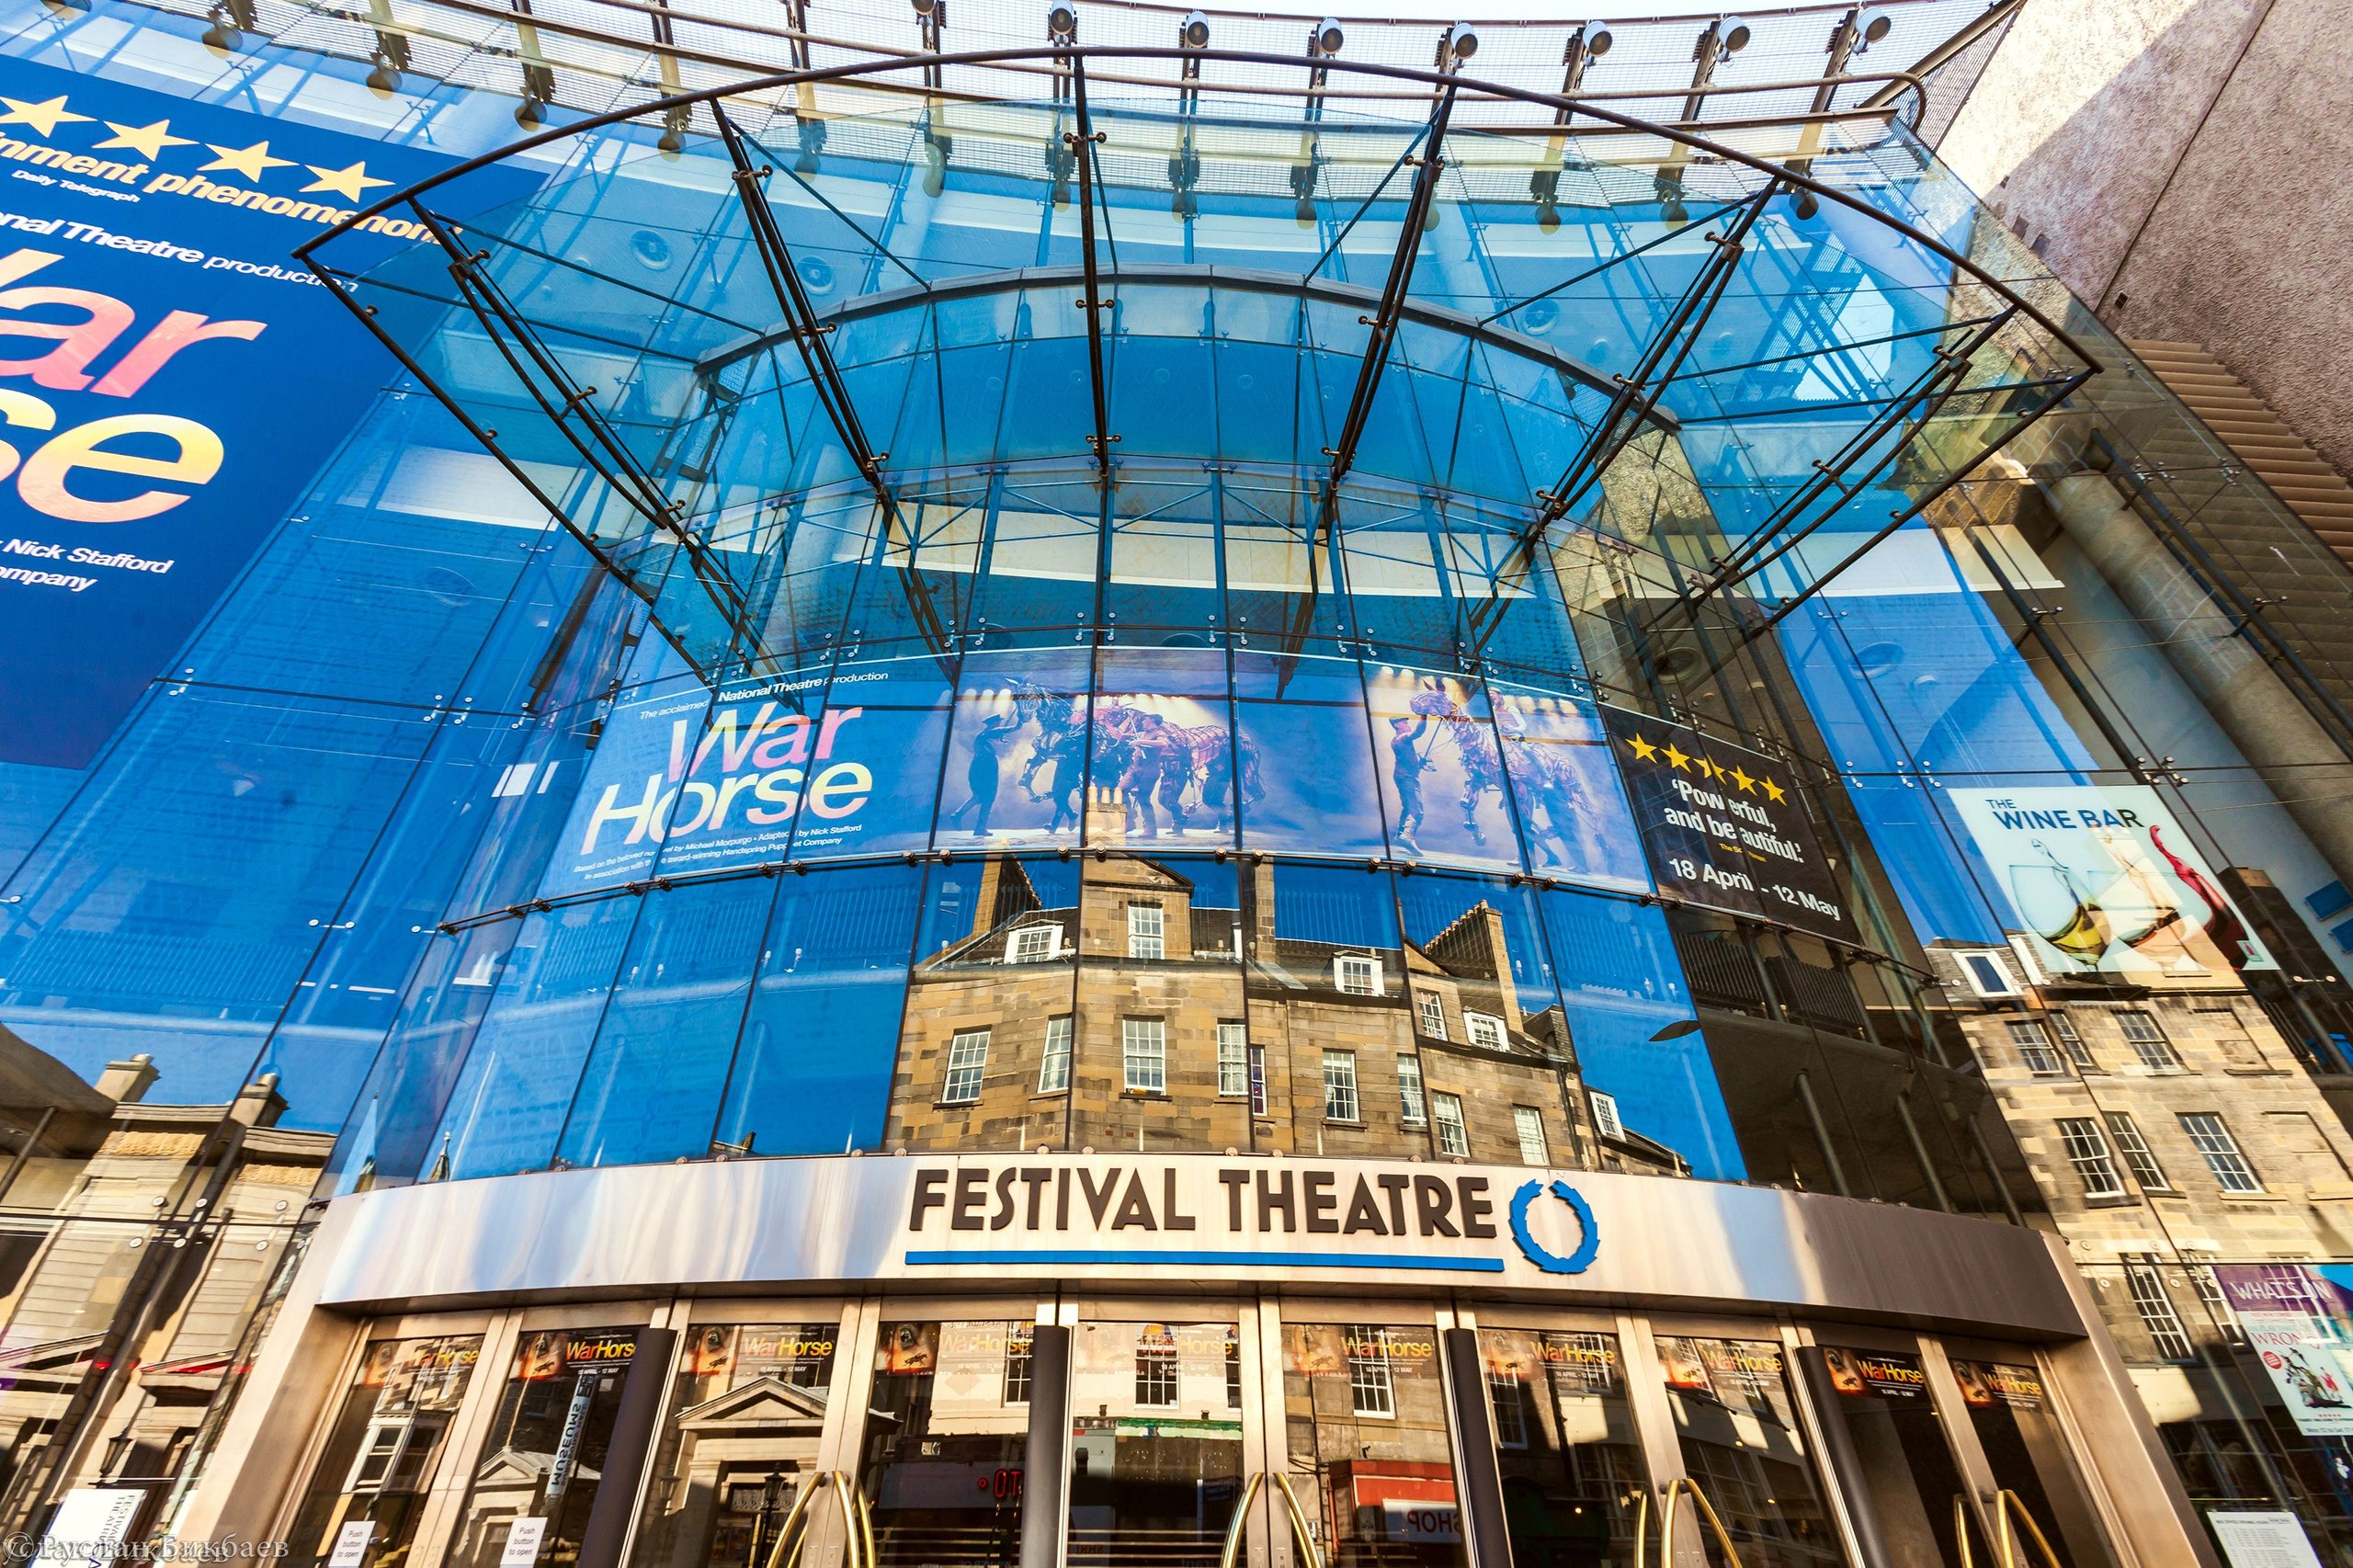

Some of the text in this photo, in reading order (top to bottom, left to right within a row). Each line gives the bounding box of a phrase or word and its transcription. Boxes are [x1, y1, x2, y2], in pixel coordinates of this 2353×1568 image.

[11, 169, 141, 203] Daily Telegraph
[63, 222, 205, 263] Theatre
[0, 248, 267, 398] ar
[3, 538, 175, 574] Nick Stafford
[640, 672, 888, 720] The acclaimed National Theatre production
[668, 702, 863, 783] War
[580, 762, 872, 857] Horse
[1985, 798, 2017, 809] THE
[1664, 807, 1707, 834] and
[1992, 808, 2145, 830] WINE BAR
[574, 861, 593, 873] Based
[618, 851, 642, 866] beloved
[674, 845, 685, 856] by
[685, 840, 715, 851] Michael
[716, 835, 752, 848] Morpurgo
[798, 829, 809, 838] by
[810, 826, 828, 835] Nick
[829, 824, 862, 835] Stafford
[592, 865, 627, 879] association
[629, 862, 644, 872] with
[667, 850, 721, 864] award-winning
[722, 845, 767, 858] Handspring
[802, 837, 843, 848] Company
[1669, 858, 1697, 881] 18
[1703, 863, 1755, 892] April
[1772, 883, 1800, 906] 12
[1797, 890, 1841, 922] May
[909, 1168, 1496, 1239] FESTIVAL THEATRE
[744, 1336, 833, 1357] WarHorse
[1856, 1359, 1924, 1384] WarHorse
[342, 1540, 361, 1548] button
[348, 1529, 363, 1538] Push
[514, 1536, 534, 1545] button
[519, 1527, 535, 1535] Push
[345, 1551, 358, 1559] open
[517, 1548, 533, 1557] open
